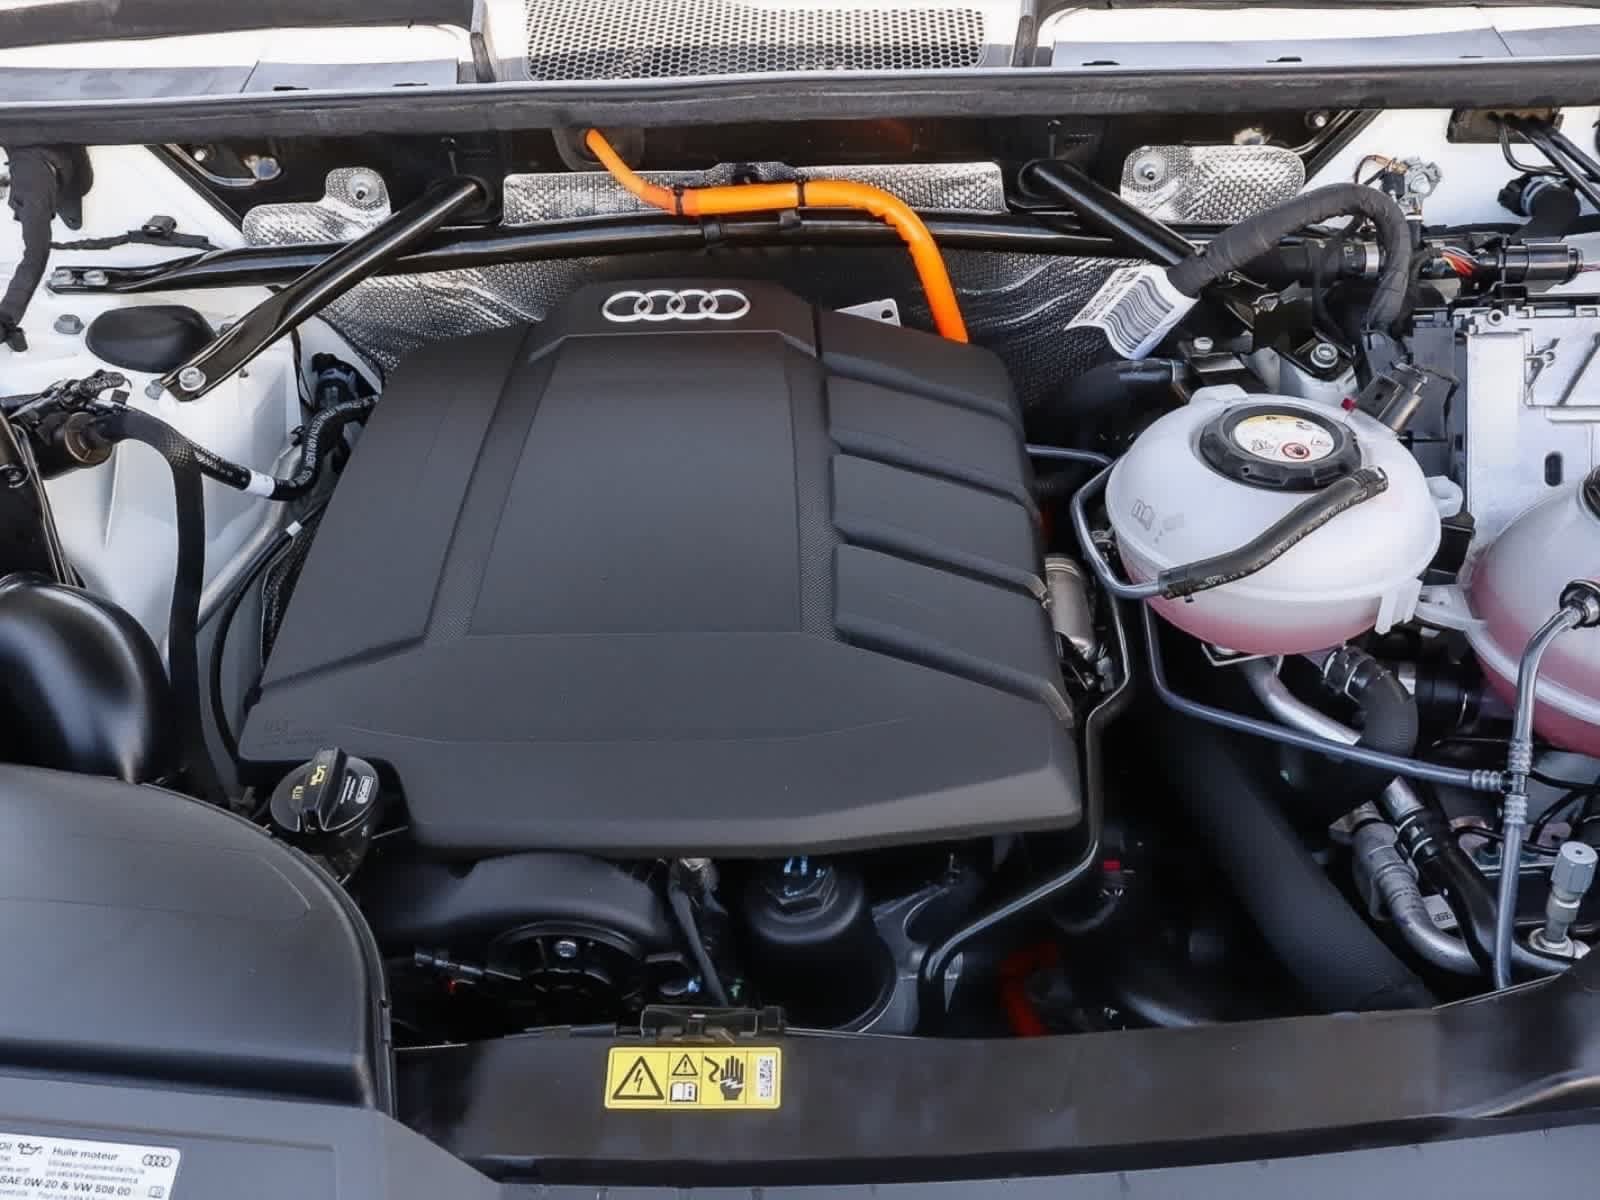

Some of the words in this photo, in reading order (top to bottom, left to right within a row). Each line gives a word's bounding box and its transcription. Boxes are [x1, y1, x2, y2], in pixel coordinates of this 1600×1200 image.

[52, 1146, 78, 1156] Huile
[80, 1151, 119, 1161] moteur
[0, 1175, 22, 1185] SAE
[61, 1181, 69, 1191] &
[73, 1182, 93, 1193] VW
[95, 1184, 115, 1194] 508
[117, 1186, 132, 1197] 00
